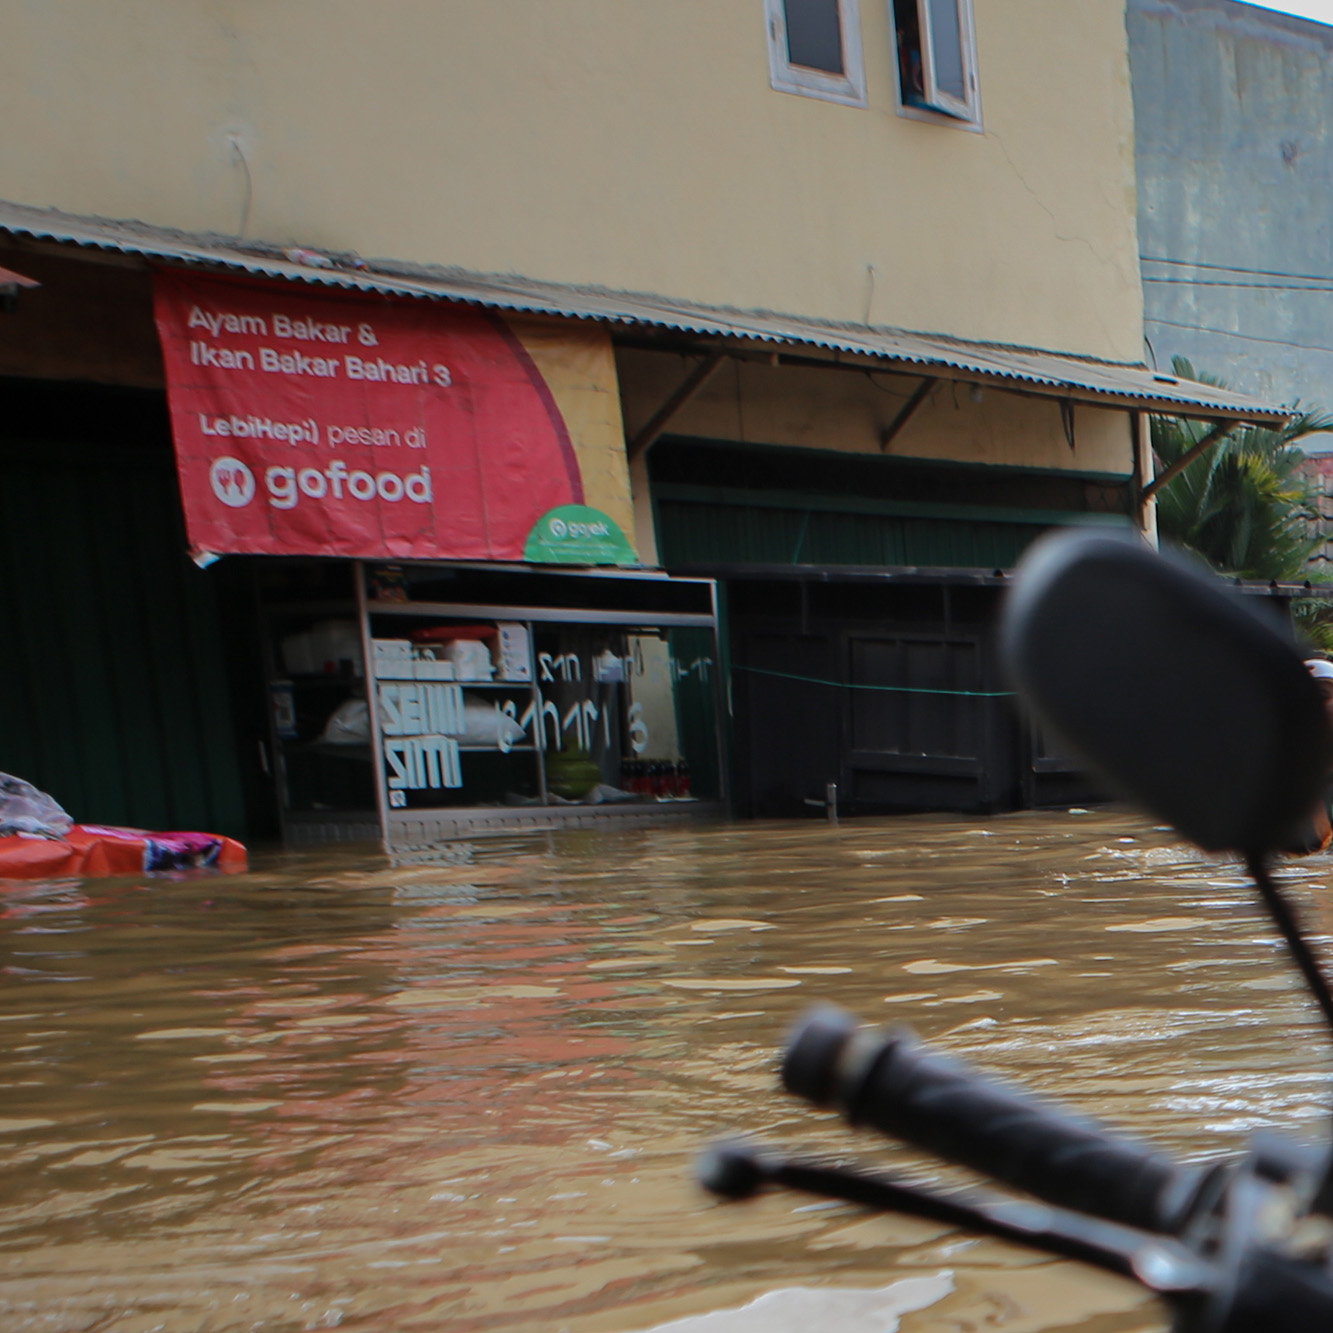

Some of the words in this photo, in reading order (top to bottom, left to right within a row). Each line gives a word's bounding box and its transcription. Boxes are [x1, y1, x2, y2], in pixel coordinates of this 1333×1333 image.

[188, 306, 268, 337] Ayam
[272, 313, 352, 344] Bakar
[357, 323, 379, 346] &
[191, 341, 255, 370] Ikan
[259, 347, 340, 378] Bakar
[344, 354, 428, 385] Bahari
[433, 363, 452, 387] 3
[327, 424, 401, 448] pesan
[404, 427, 427, 448] di
[265, 459, 433, 509] gofood
